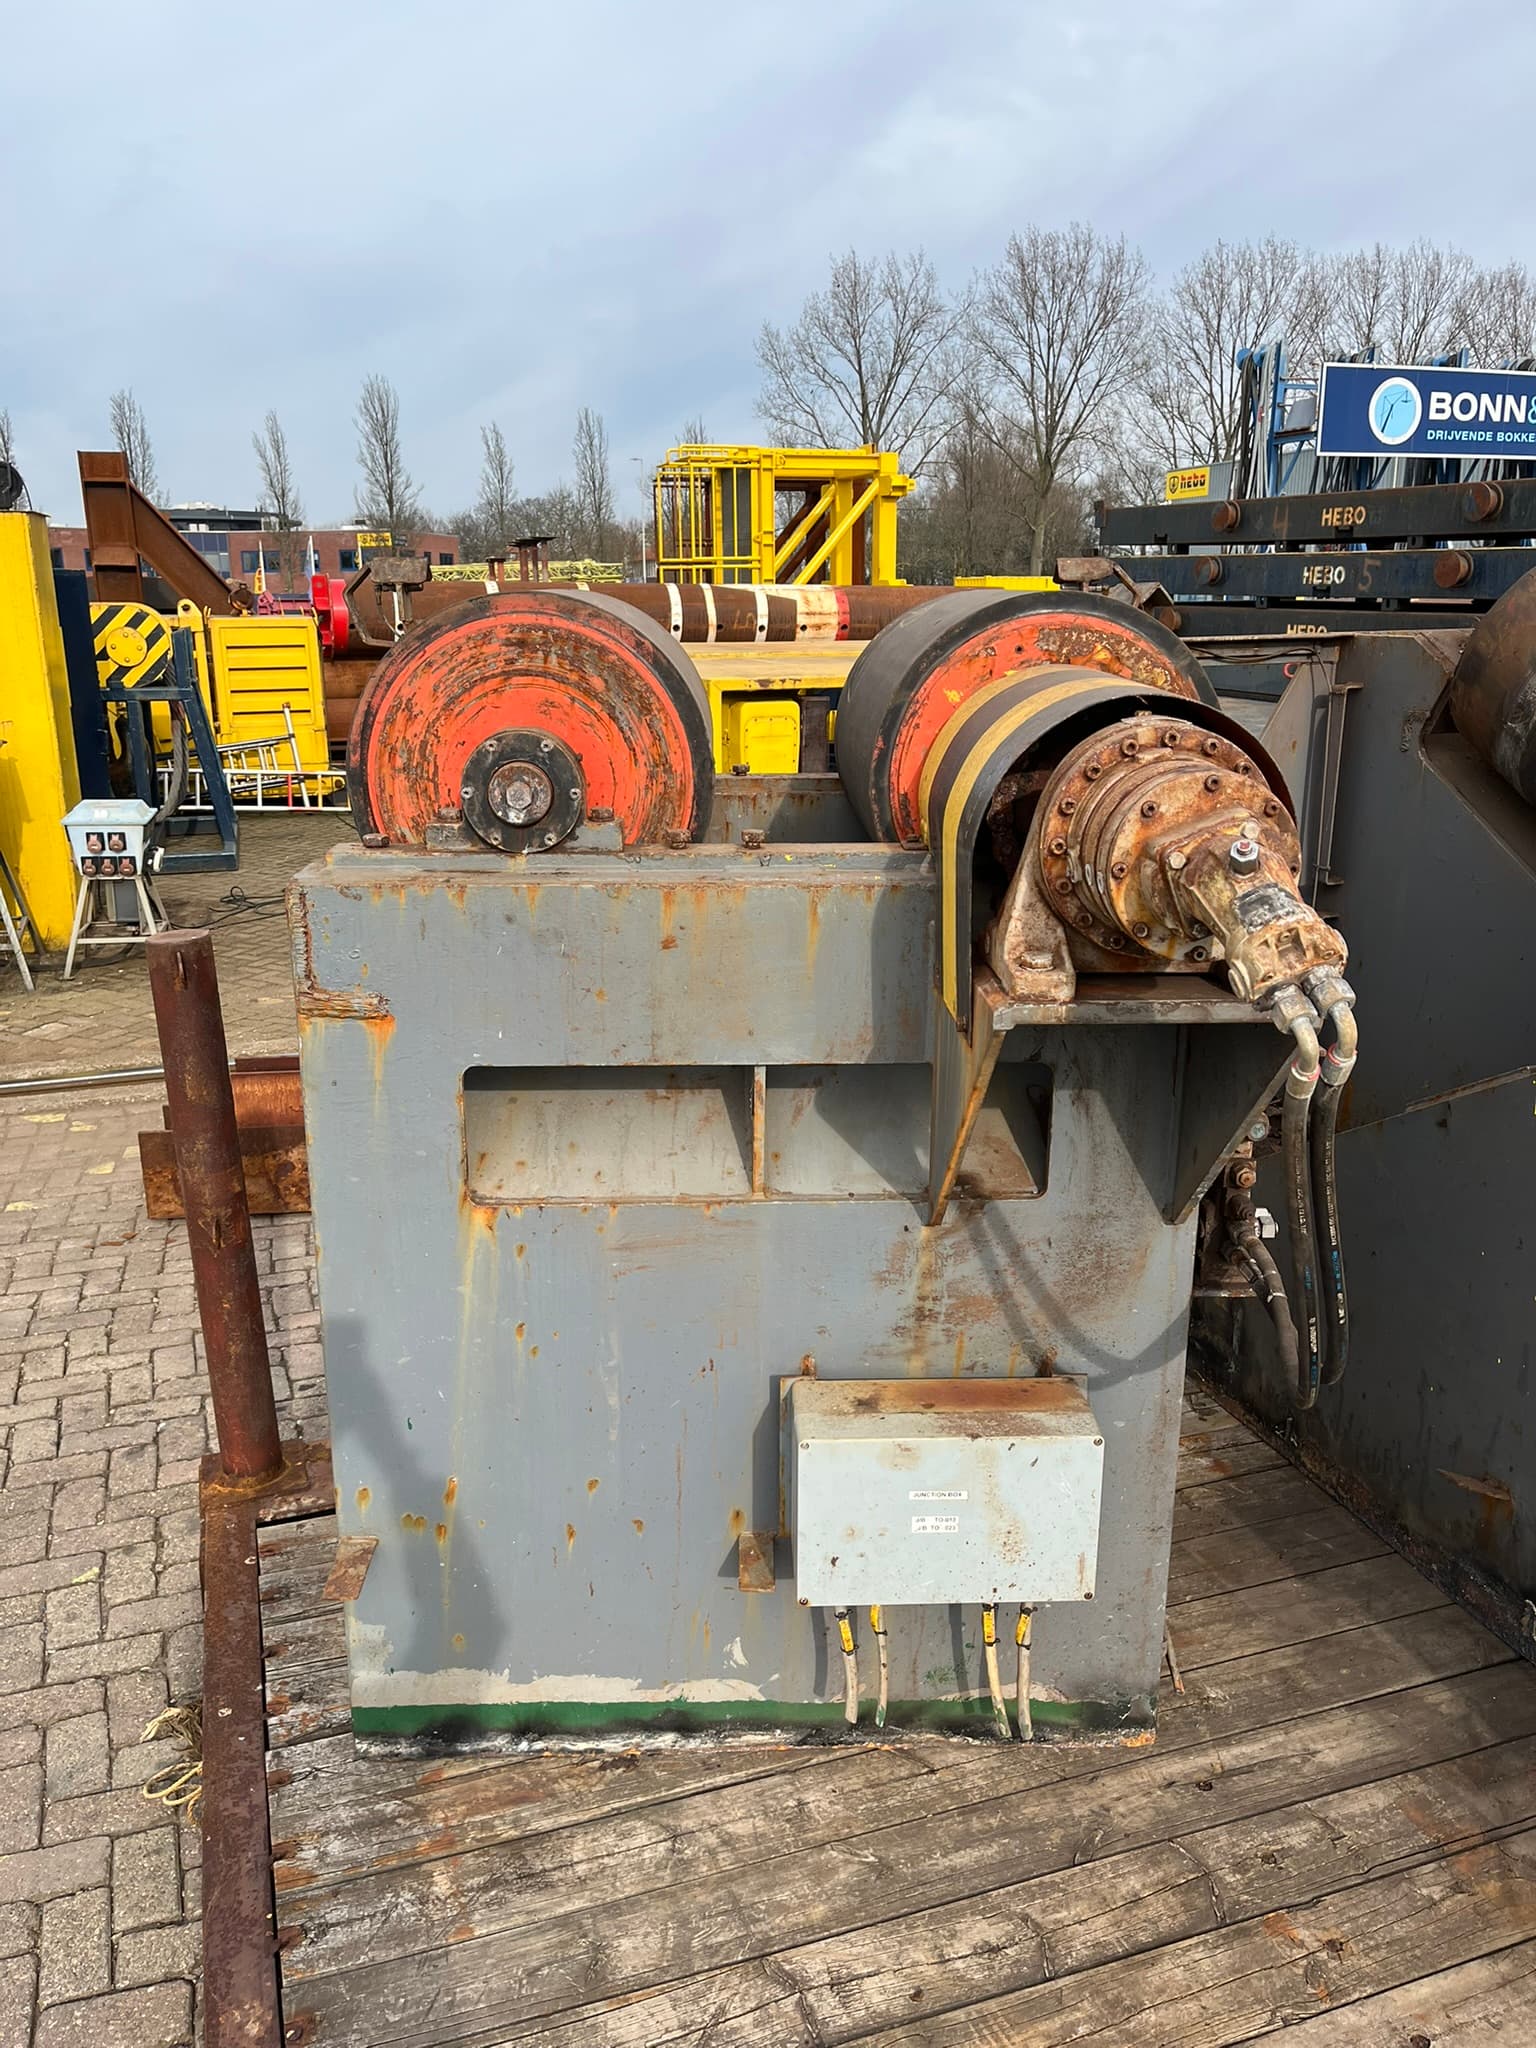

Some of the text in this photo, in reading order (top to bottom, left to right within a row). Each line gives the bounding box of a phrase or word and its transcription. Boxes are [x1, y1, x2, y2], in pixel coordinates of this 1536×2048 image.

[1427, 430, 1493, 441] DRIJVENDE
[1180, 473, 1206, 489] hebo
[1321, 505, 1366, 527] HEBO
[1303, 565, 1346, 585] HEBO
